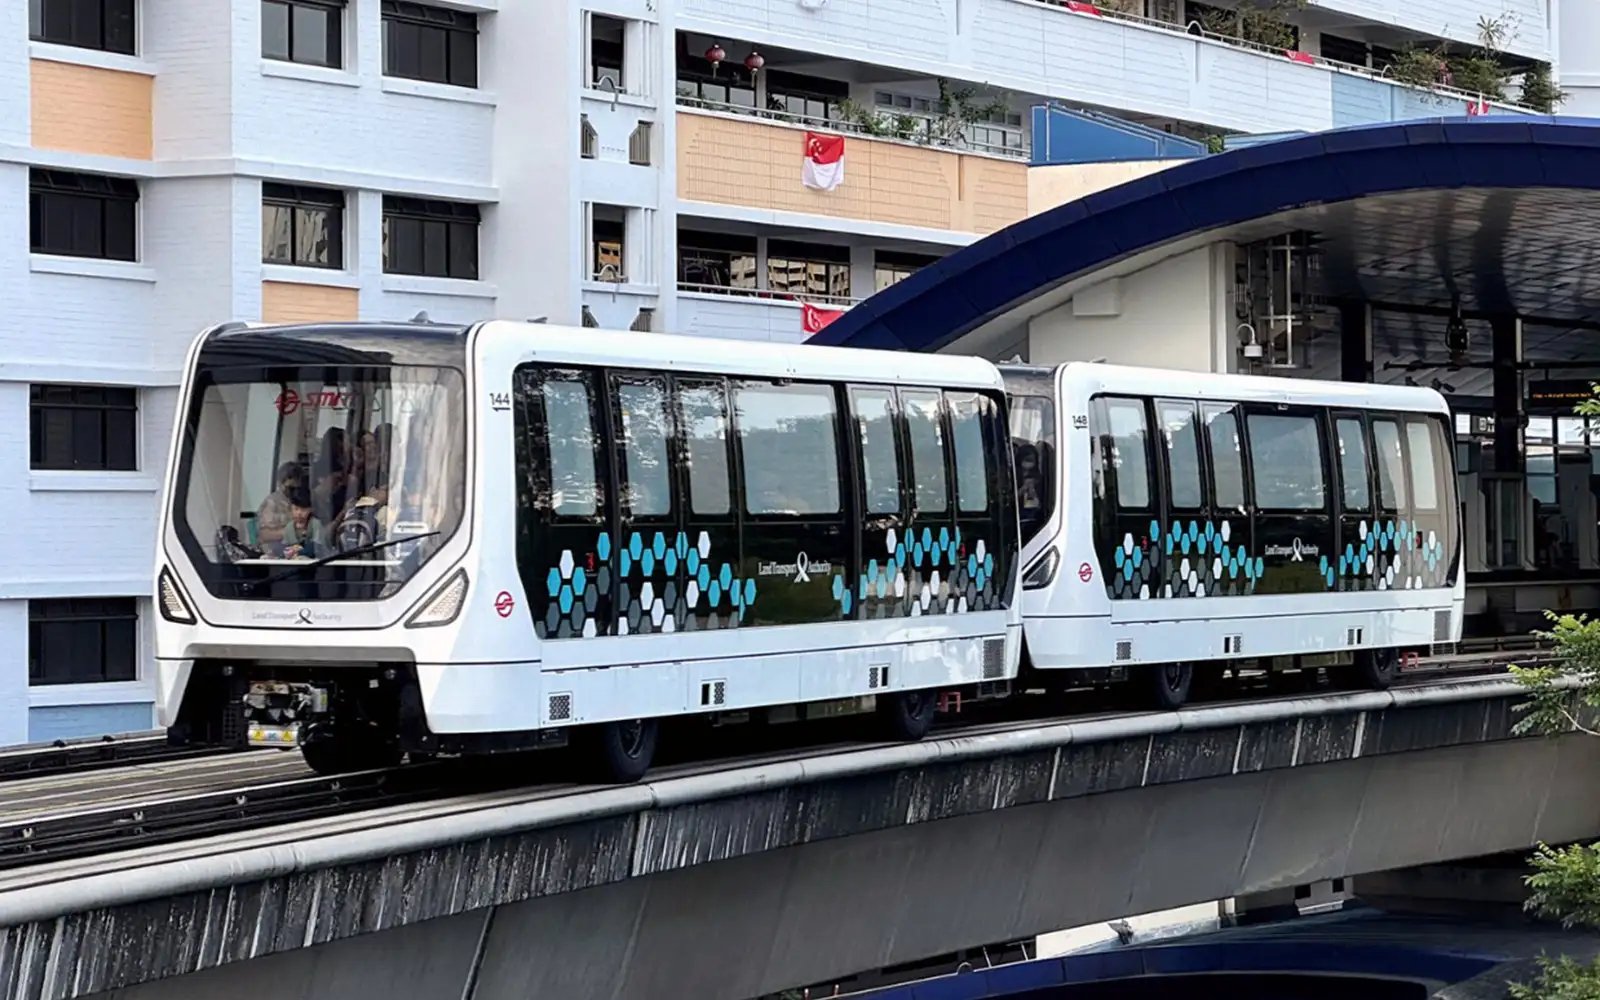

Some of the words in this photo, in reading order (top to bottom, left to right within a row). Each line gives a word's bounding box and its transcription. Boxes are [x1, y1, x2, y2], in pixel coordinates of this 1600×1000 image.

[489, 392, 510, 405] 144
[758, 561, 772, 575] Land
[769, 561, 797, 577] Transport
[807, 560, 832, 576] Authority
